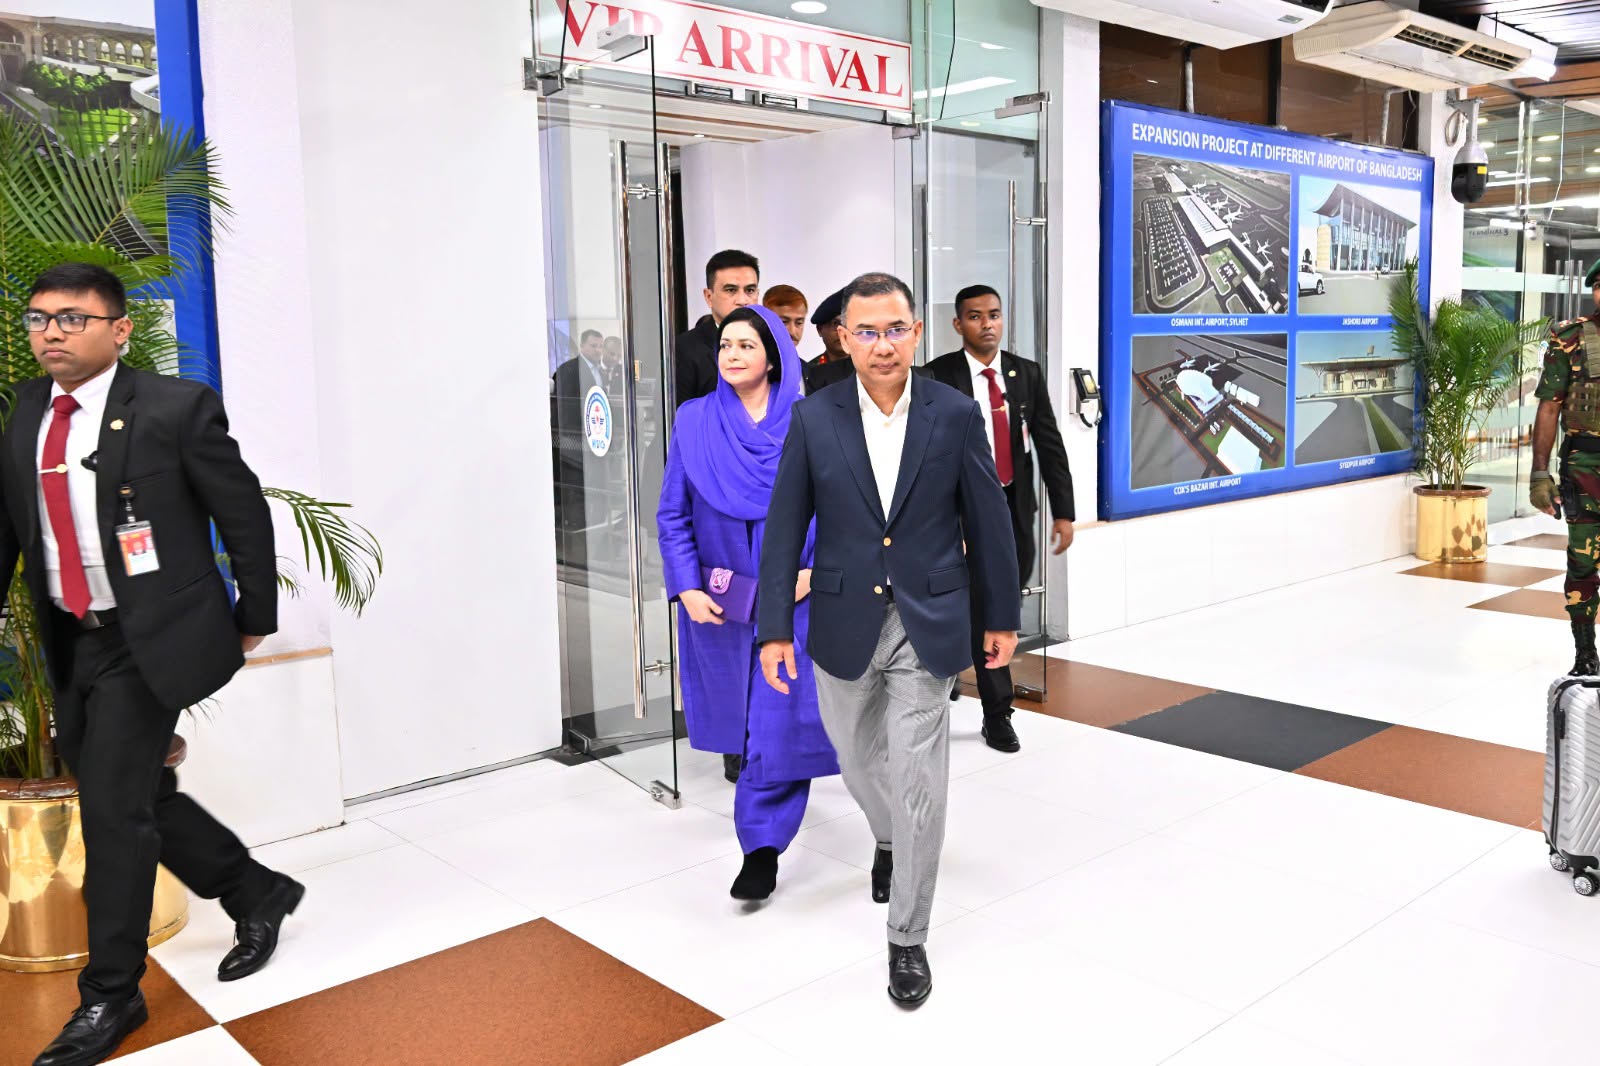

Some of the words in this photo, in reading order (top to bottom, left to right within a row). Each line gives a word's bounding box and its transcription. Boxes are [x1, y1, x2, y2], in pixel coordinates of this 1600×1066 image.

[677, 20, 902, 97] ARRIVAL
[1132, 123, 1199, 149] EXPANSION
[1202, 133, 1248, 157] PROJECT
[1250, 142, 1263, 158] AT
[1265, 144, 1315, 165] DIFFERENT
[1318, 153, 1354, 172] AIRPORT
[1356, 160, 1368, 174] OF
[1370, 162, 1422, 182] BANGLADESH
[1171, 318, 1193, 327] OSMANI
[1194, 318, 1204, 326] INT.
[1205, 318, 1228, 327] AIRPORT,
[1229, 317, 1248, 327] SYLHET
[1174, 485, 1190, 495] COX'S
[1190, 482, 1208, 493] BAZAR
[1208, 480, 1219, 490] INT.
[1219, 476, 1242, 488] AIRPORT
